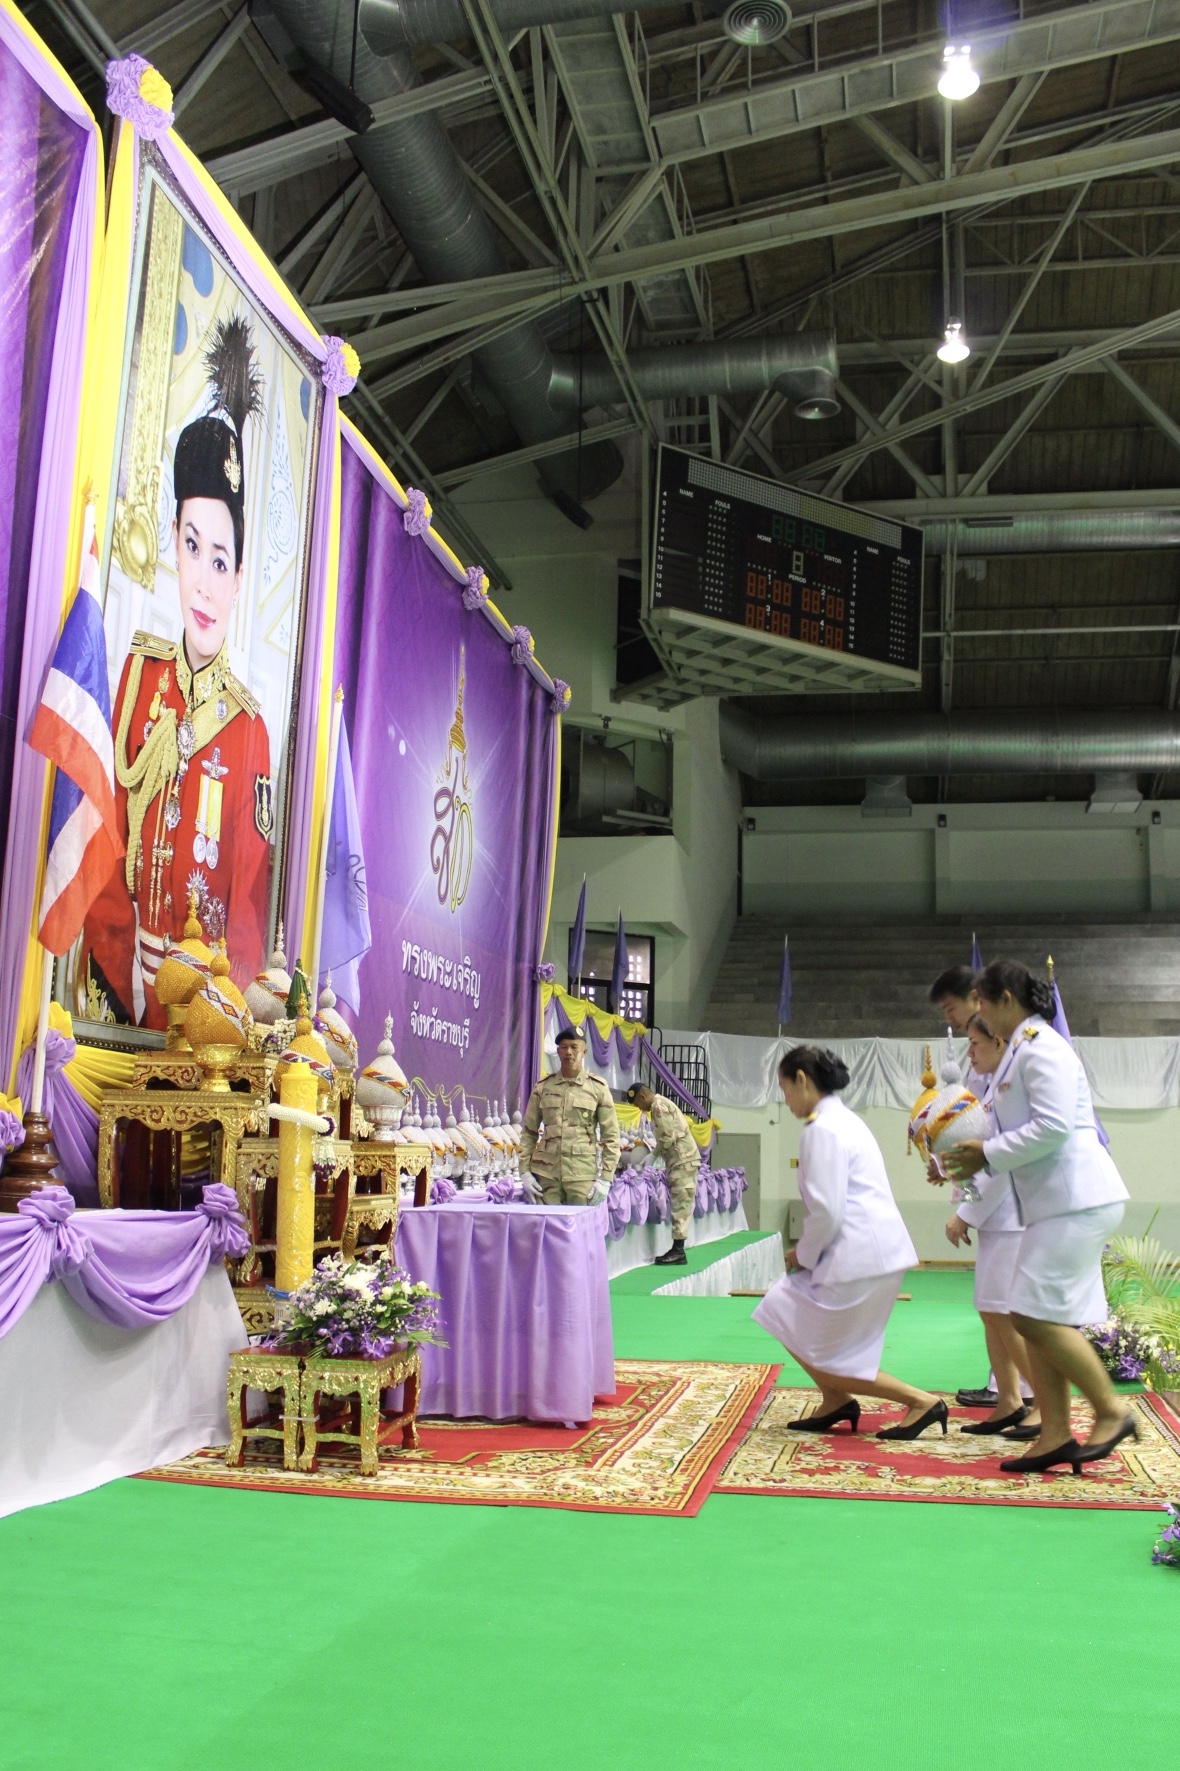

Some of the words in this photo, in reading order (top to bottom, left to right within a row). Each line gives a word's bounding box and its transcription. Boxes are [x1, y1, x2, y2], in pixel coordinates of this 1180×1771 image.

[679, 488, 693, 498] NAME
[715, 500, 731, 509] FOULS
[757, 533, 773, 543] HOME
[866, 546, 879, 555] NAME
[824, 554, 842, 564] VISITOR
[788, 574, 807, 583] PERIOD
[401, 939, 481, 1010] ทรงพระเจริญ
[410, 1000, 471, 1059] จังหวัดราชบุรี
